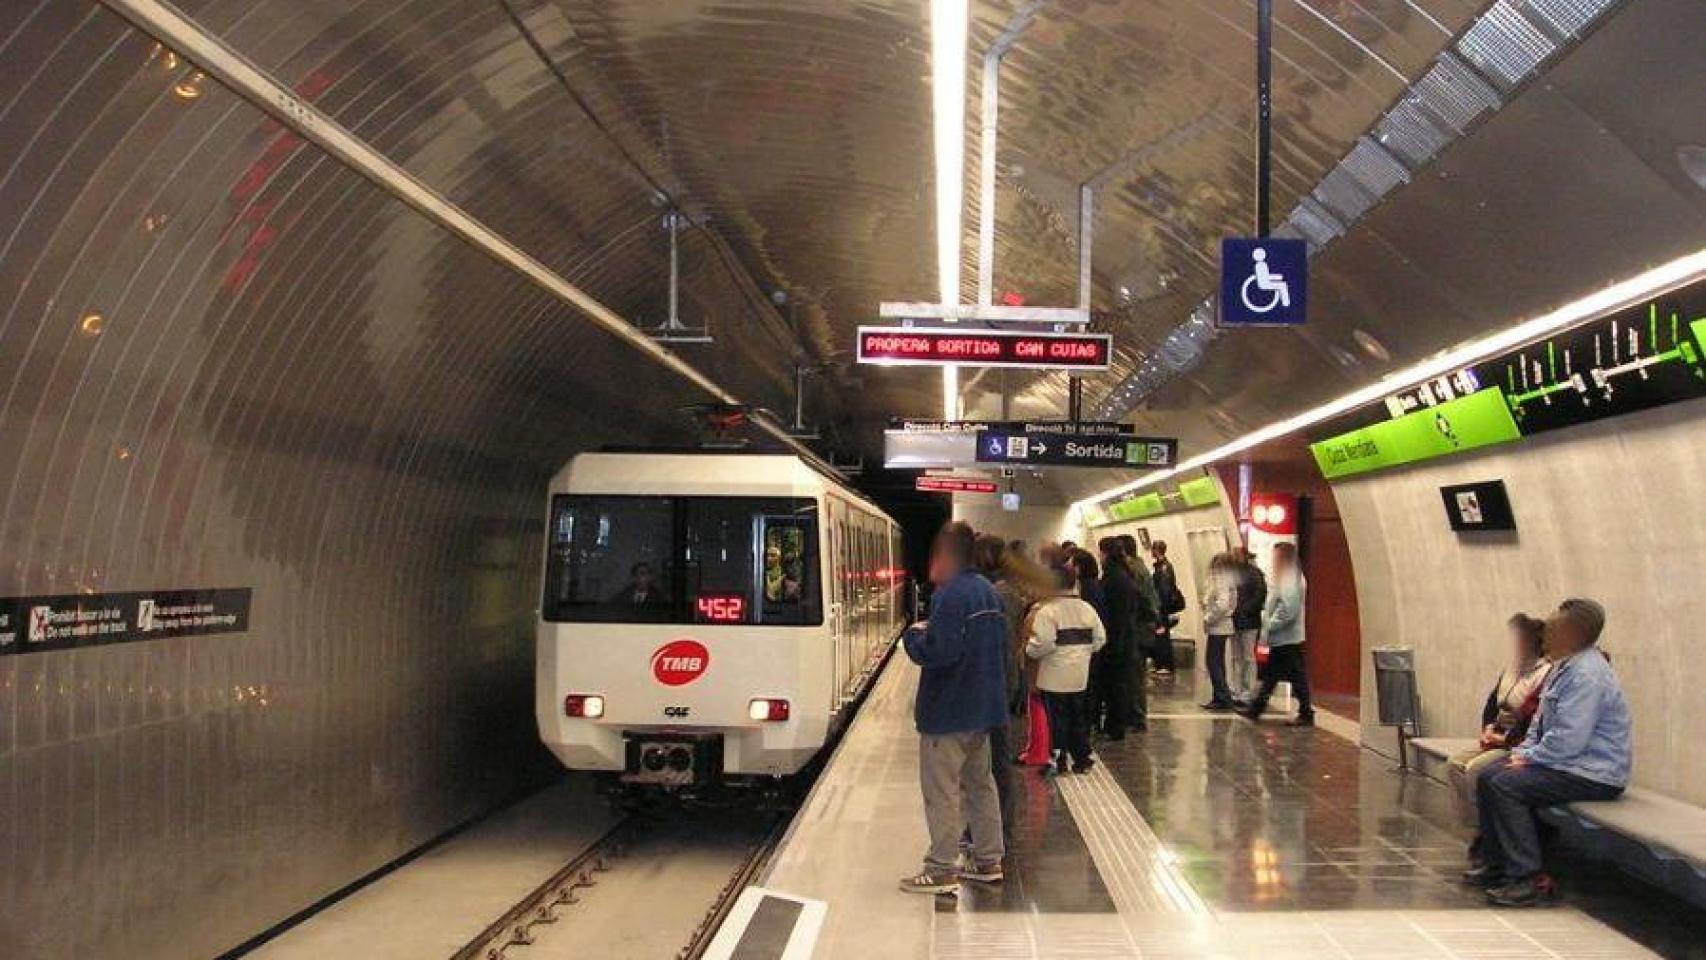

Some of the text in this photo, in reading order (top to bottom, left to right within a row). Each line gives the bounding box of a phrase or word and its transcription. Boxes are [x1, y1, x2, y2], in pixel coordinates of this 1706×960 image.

[866, 336, 930, 353] PROPERA
[937, 340, 1000, 355] SORTIDA
[1015, 341, 1044, 357] CAN
[1065, 442, 1124, 459] Sortida
[698, 598, 742, 619] 452
[662, 657, 702, 672] TMB
